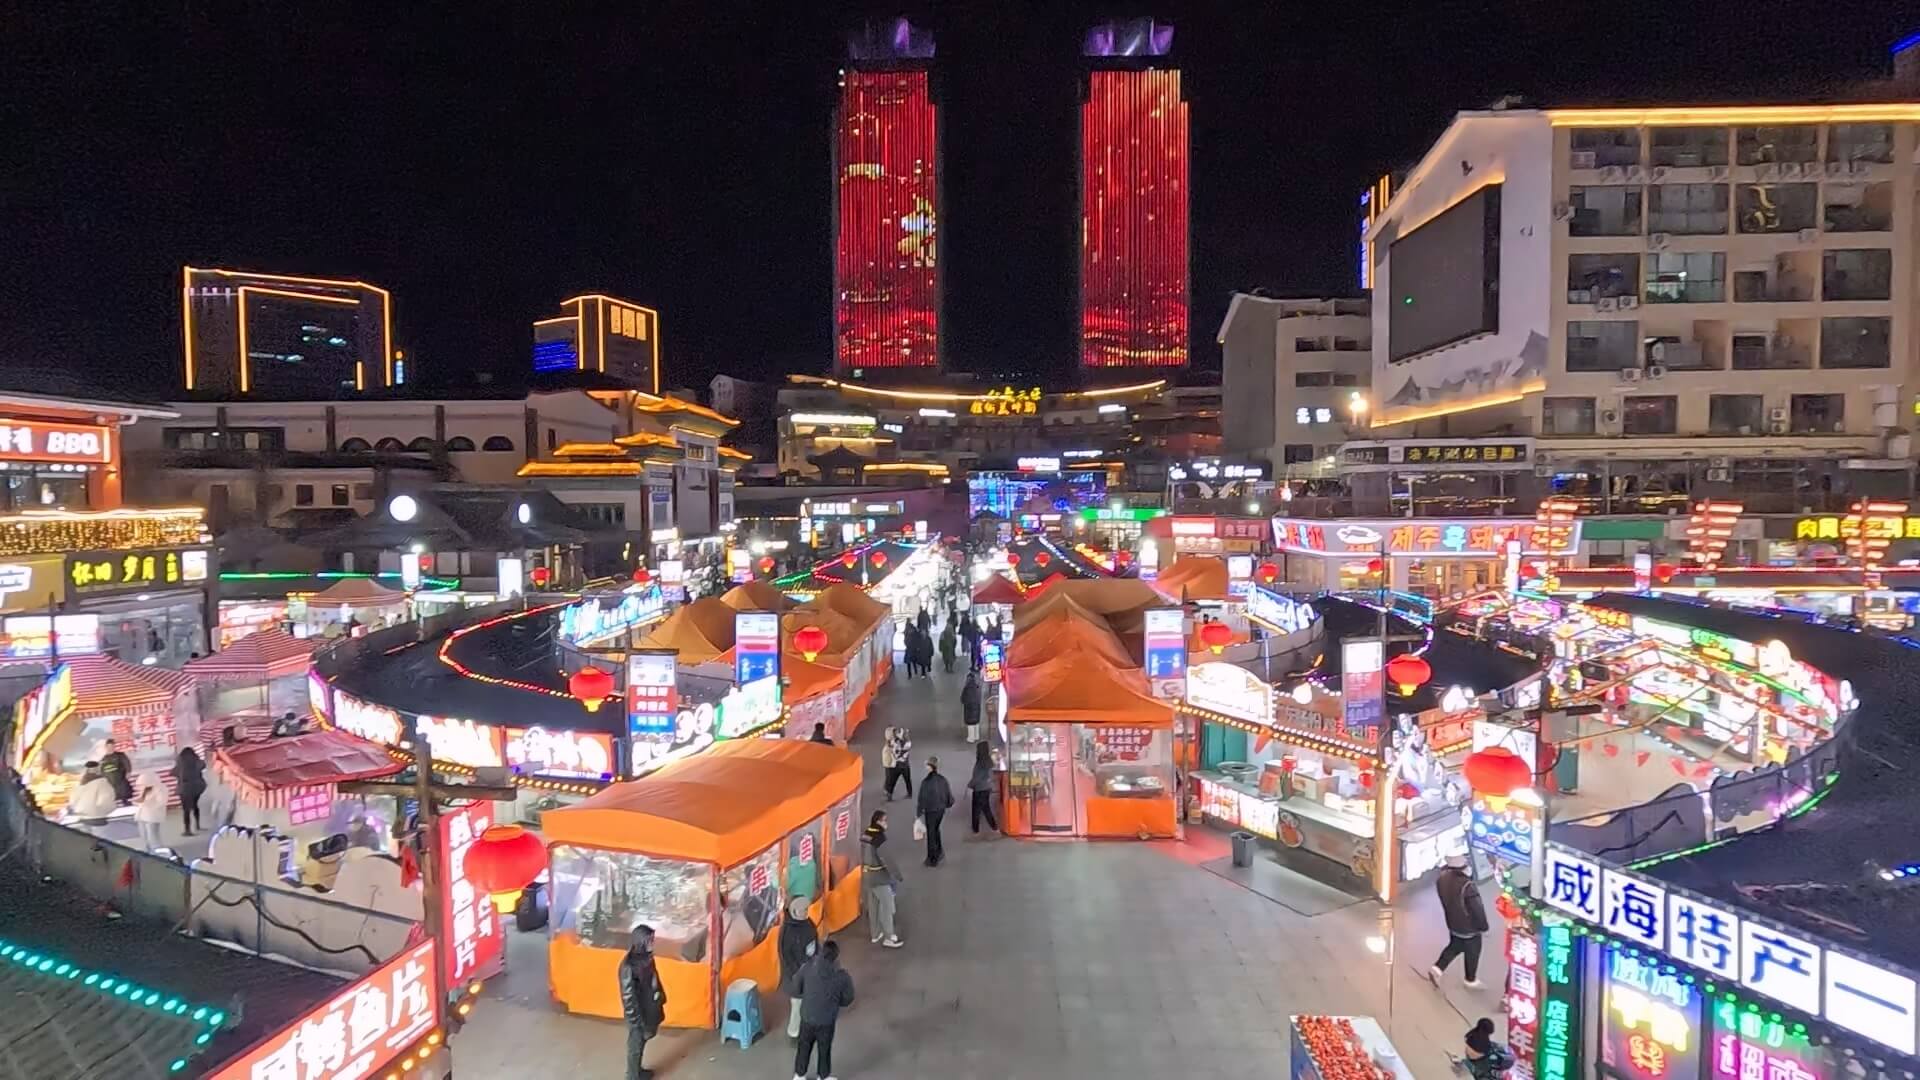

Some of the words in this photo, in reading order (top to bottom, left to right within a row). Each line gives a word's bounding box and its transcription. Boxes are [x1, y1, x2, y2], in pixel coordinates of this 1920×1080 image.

[47, 431, 99, 455] BBQ
[1550, 863, 1909, 1015] 威海特产一
